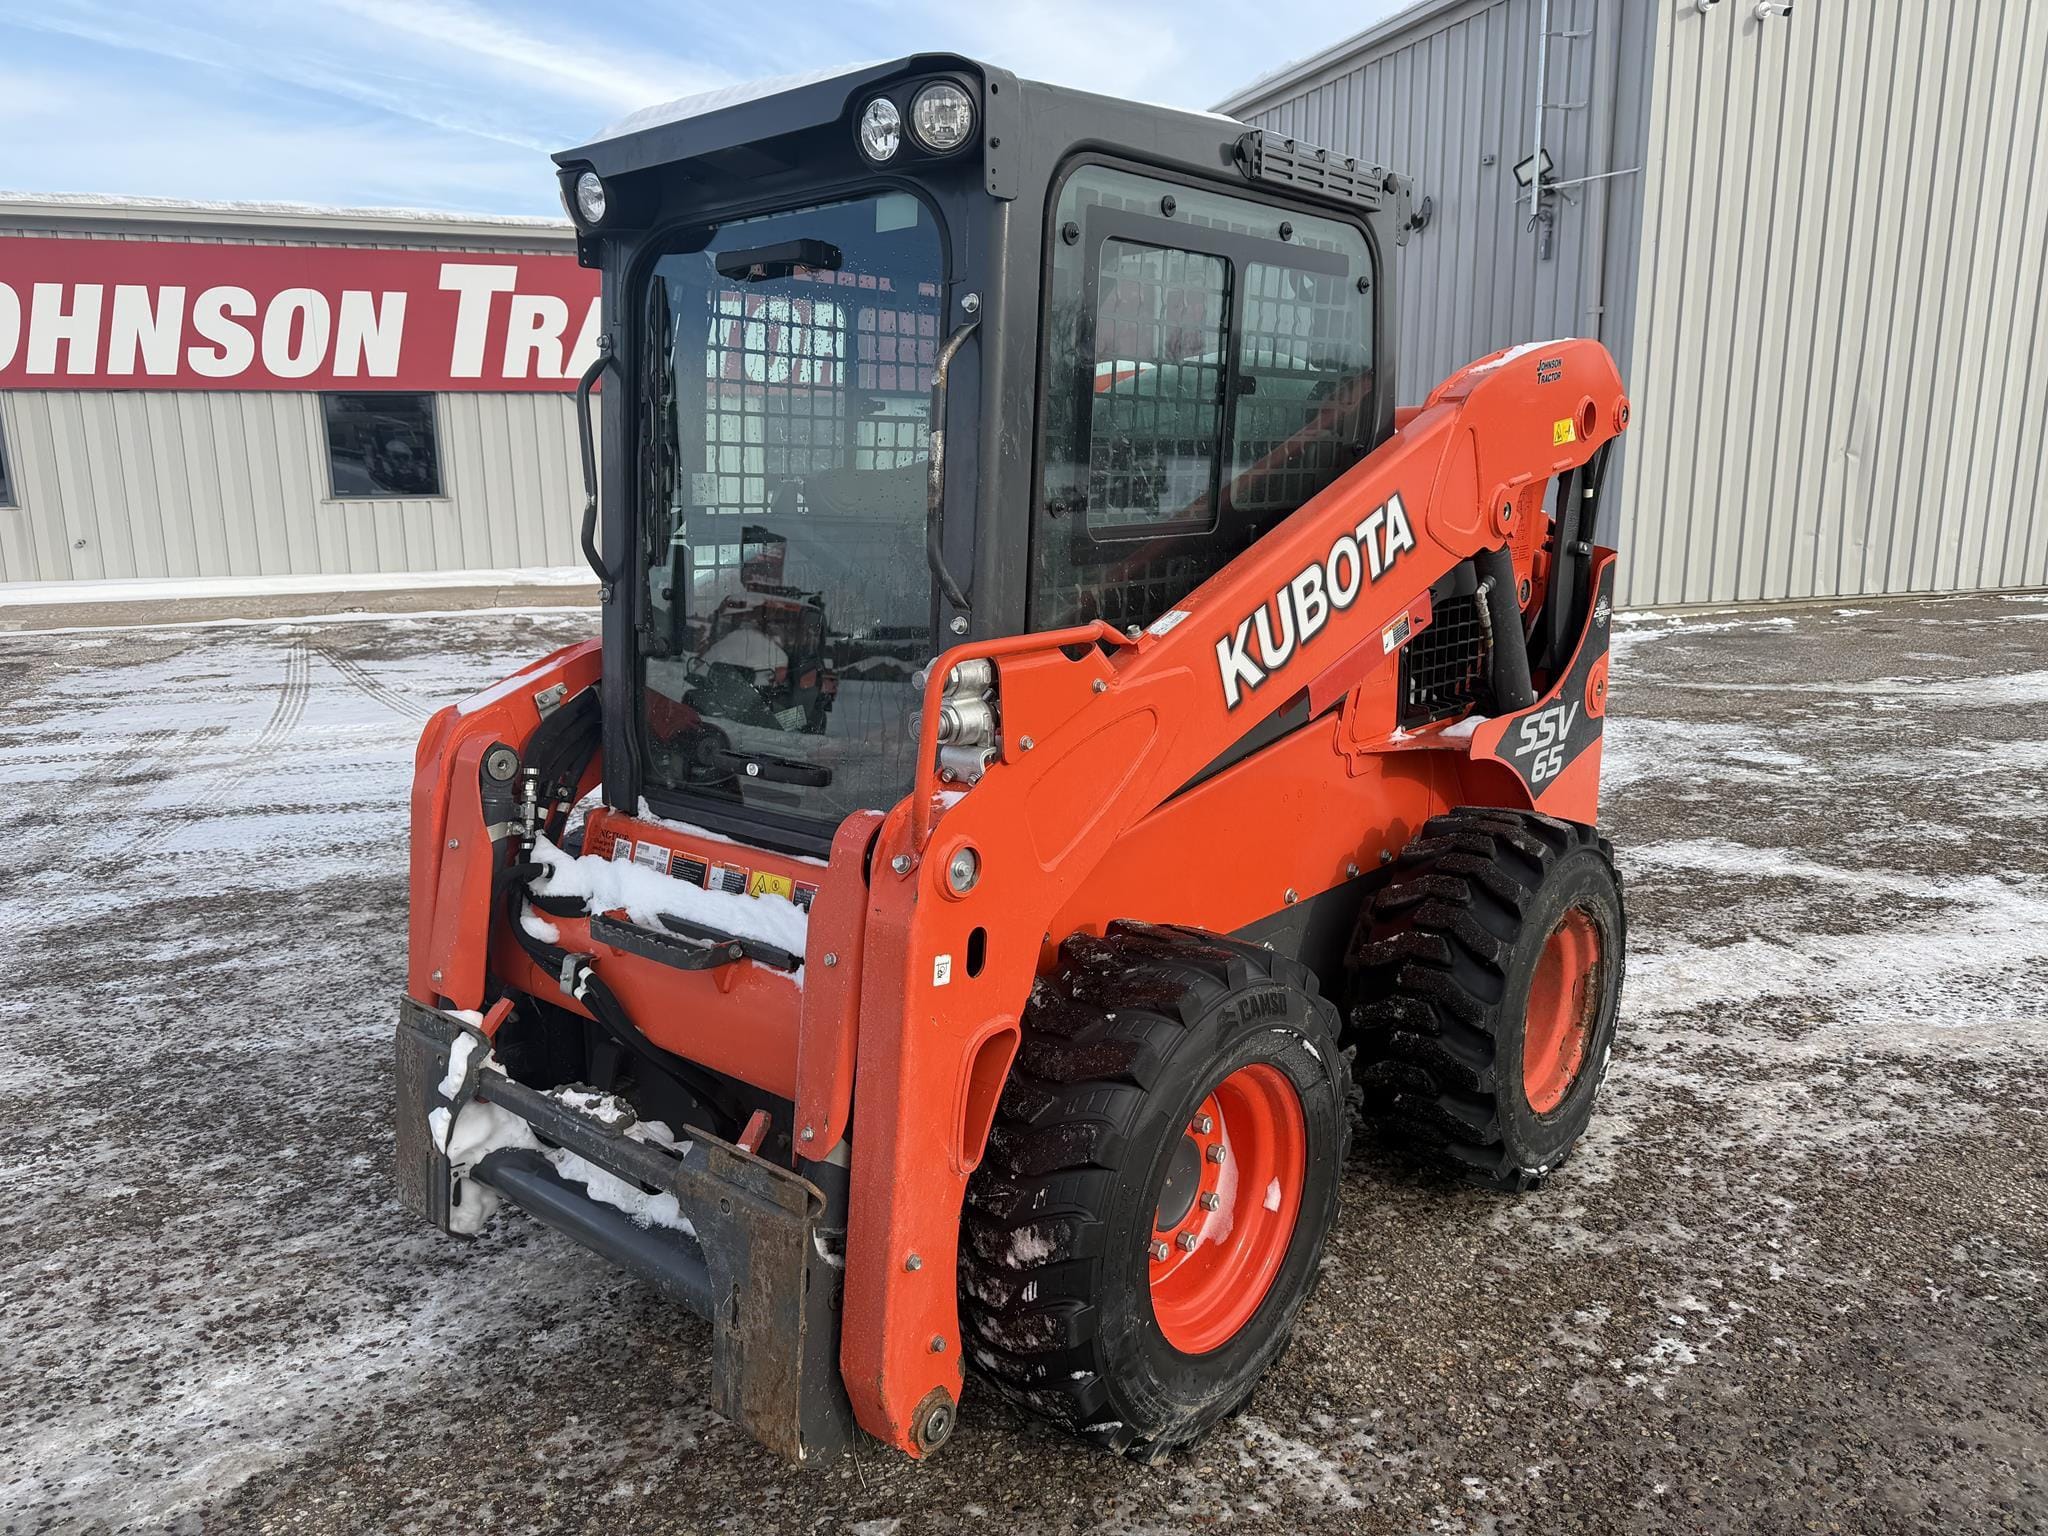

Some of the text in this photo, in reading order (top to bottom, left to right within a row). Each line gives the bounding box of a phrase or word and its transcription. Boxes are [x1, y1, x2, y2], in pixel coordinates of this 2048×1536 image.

[1536, 359, 1562, 372] JOHNSON
[1537, 372, 1562, 385] TRACTOR
[1215, 493, 1415, 710] KUBOTA
[1515, 701, 1579, 757] SSV
[1531, 744, 1565, 783] 65
[1237, 992, 1288, 1024] CAMSO
